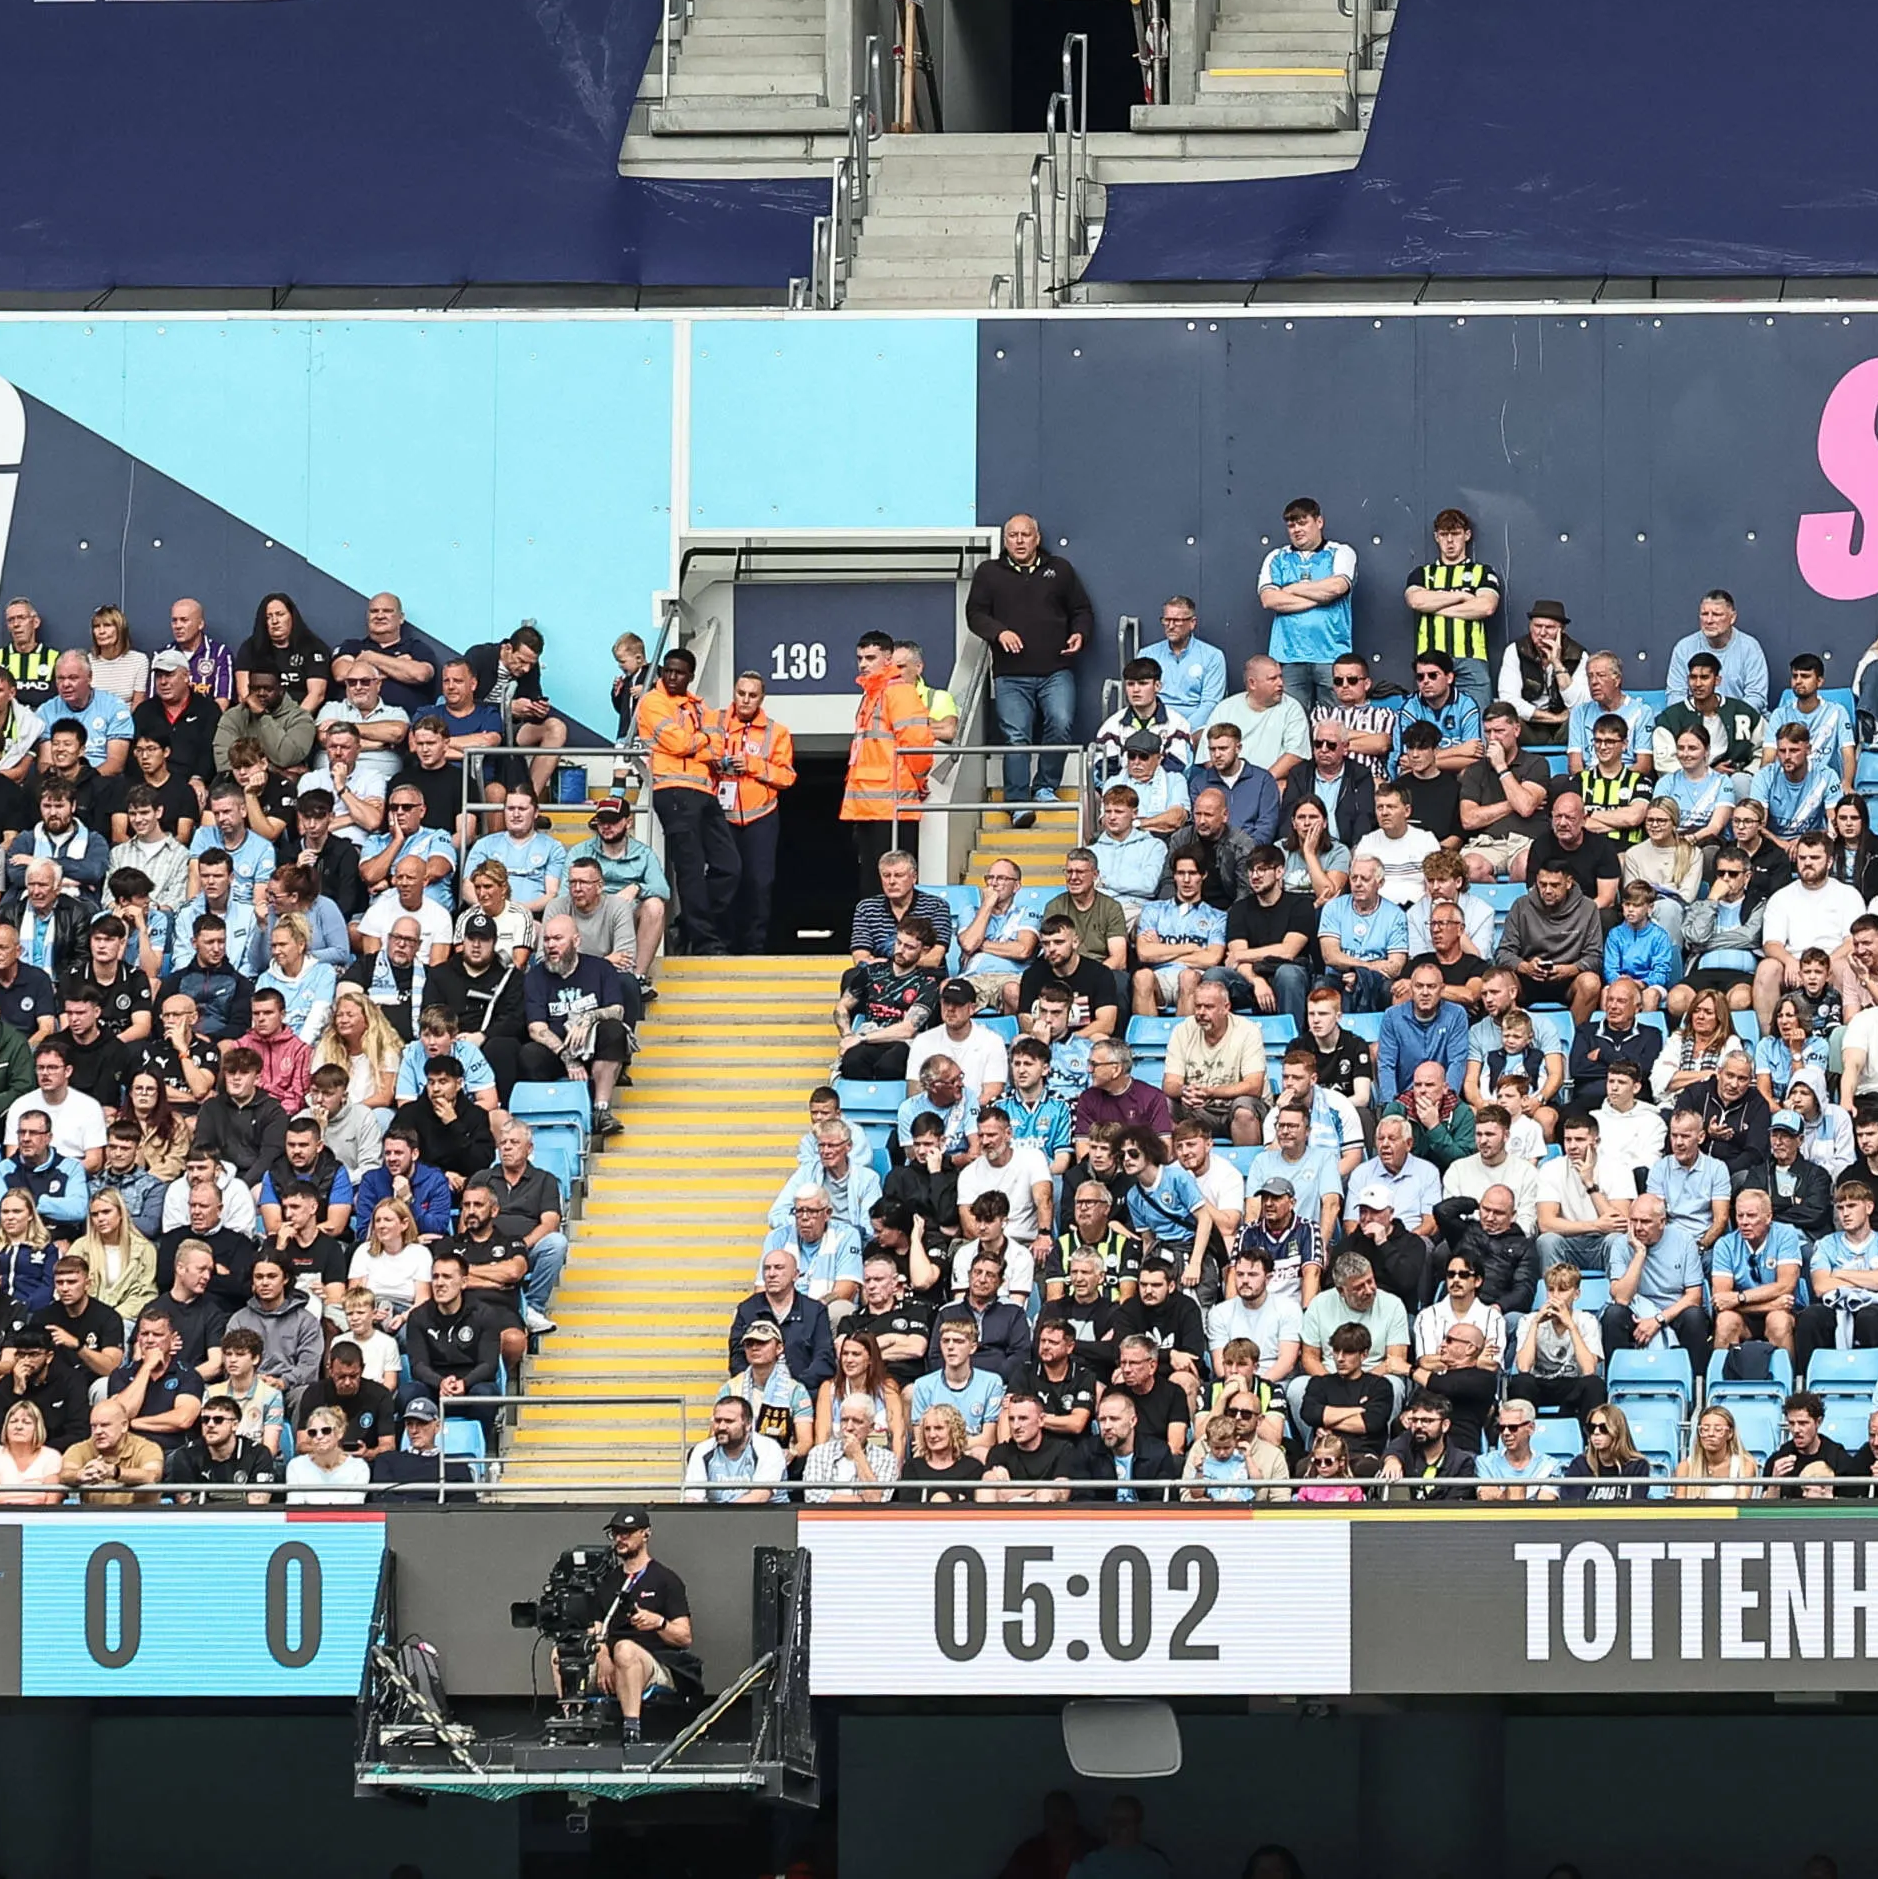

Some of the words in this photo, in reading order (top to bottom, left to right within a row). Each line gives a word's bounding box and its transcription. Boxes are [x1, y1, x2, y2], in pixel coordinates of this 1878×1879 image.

[770, 642, 827, 681] 136
[1734, 714, 1752, 741] R
[84, 1541, 142, 1669] 0
[265, 1541, 323, 1668] 0
[934, 1544, 1220, 1663] 05:02
